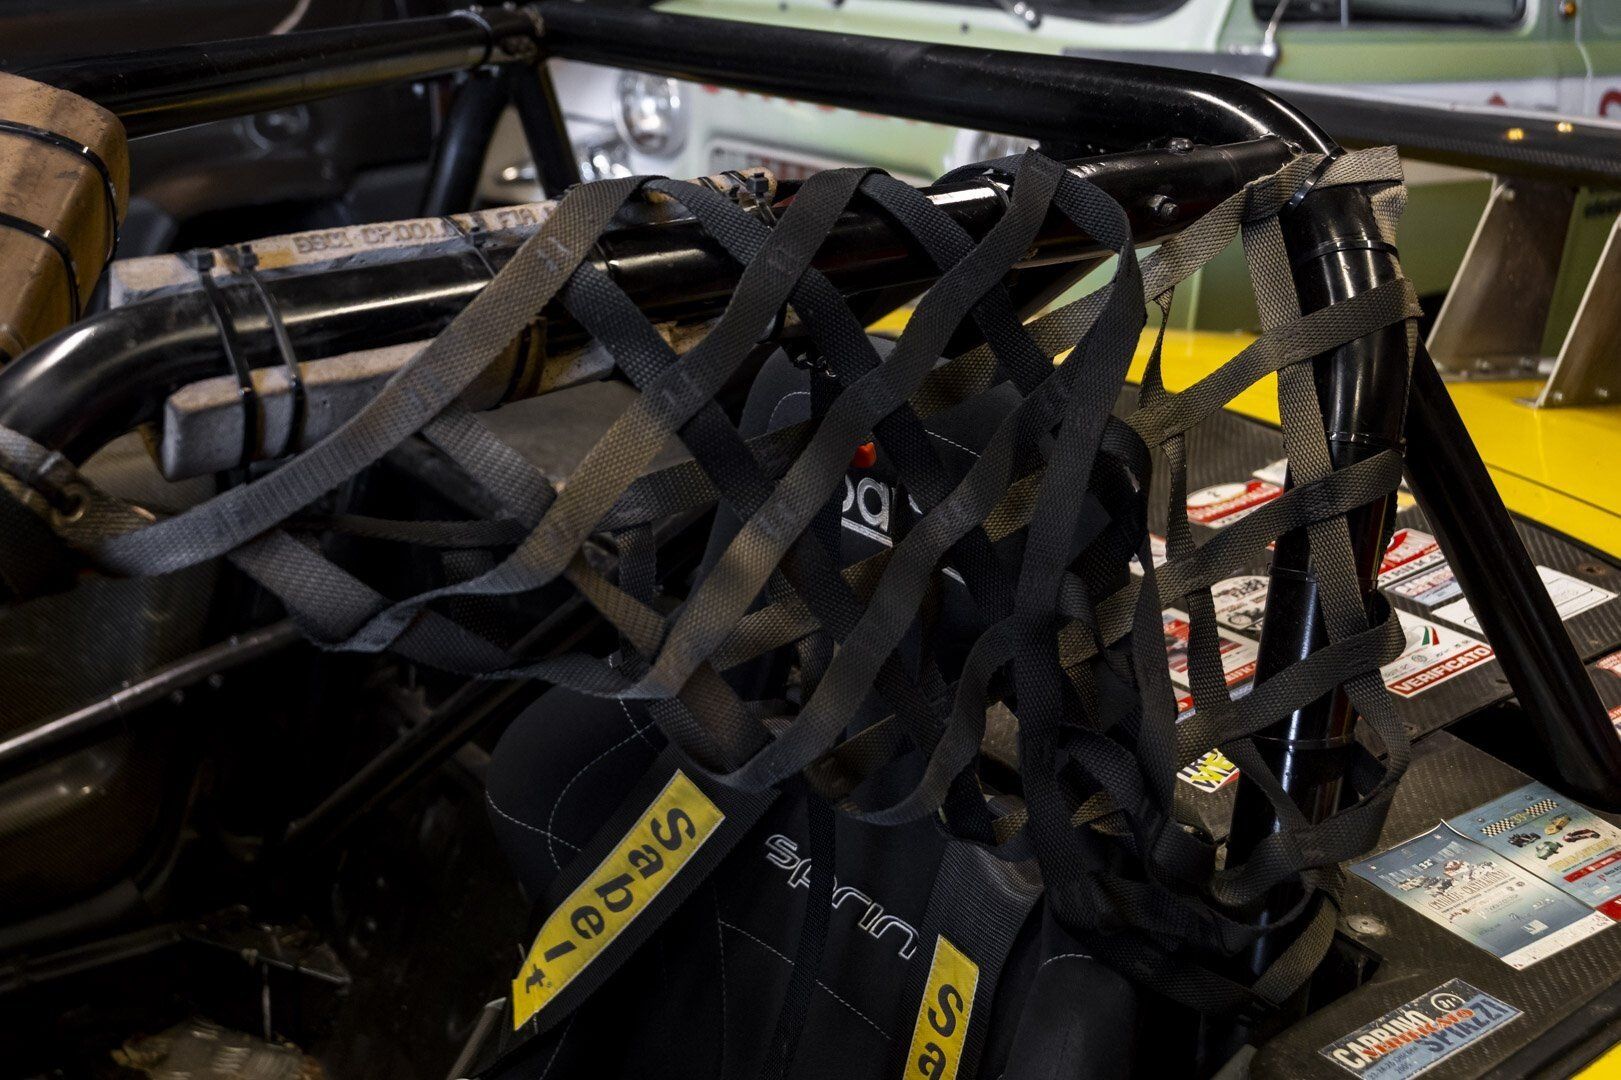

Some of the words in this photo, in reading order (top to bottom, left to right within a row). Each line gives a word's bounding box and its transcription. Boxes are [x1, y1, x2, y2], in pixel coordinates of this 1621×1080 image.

[1394, 647, 1492, 692] VERIFICATO
[525, 808, 696, 994] Sabelt
[1417, 999, 1510, 1053] SPIAZZI
